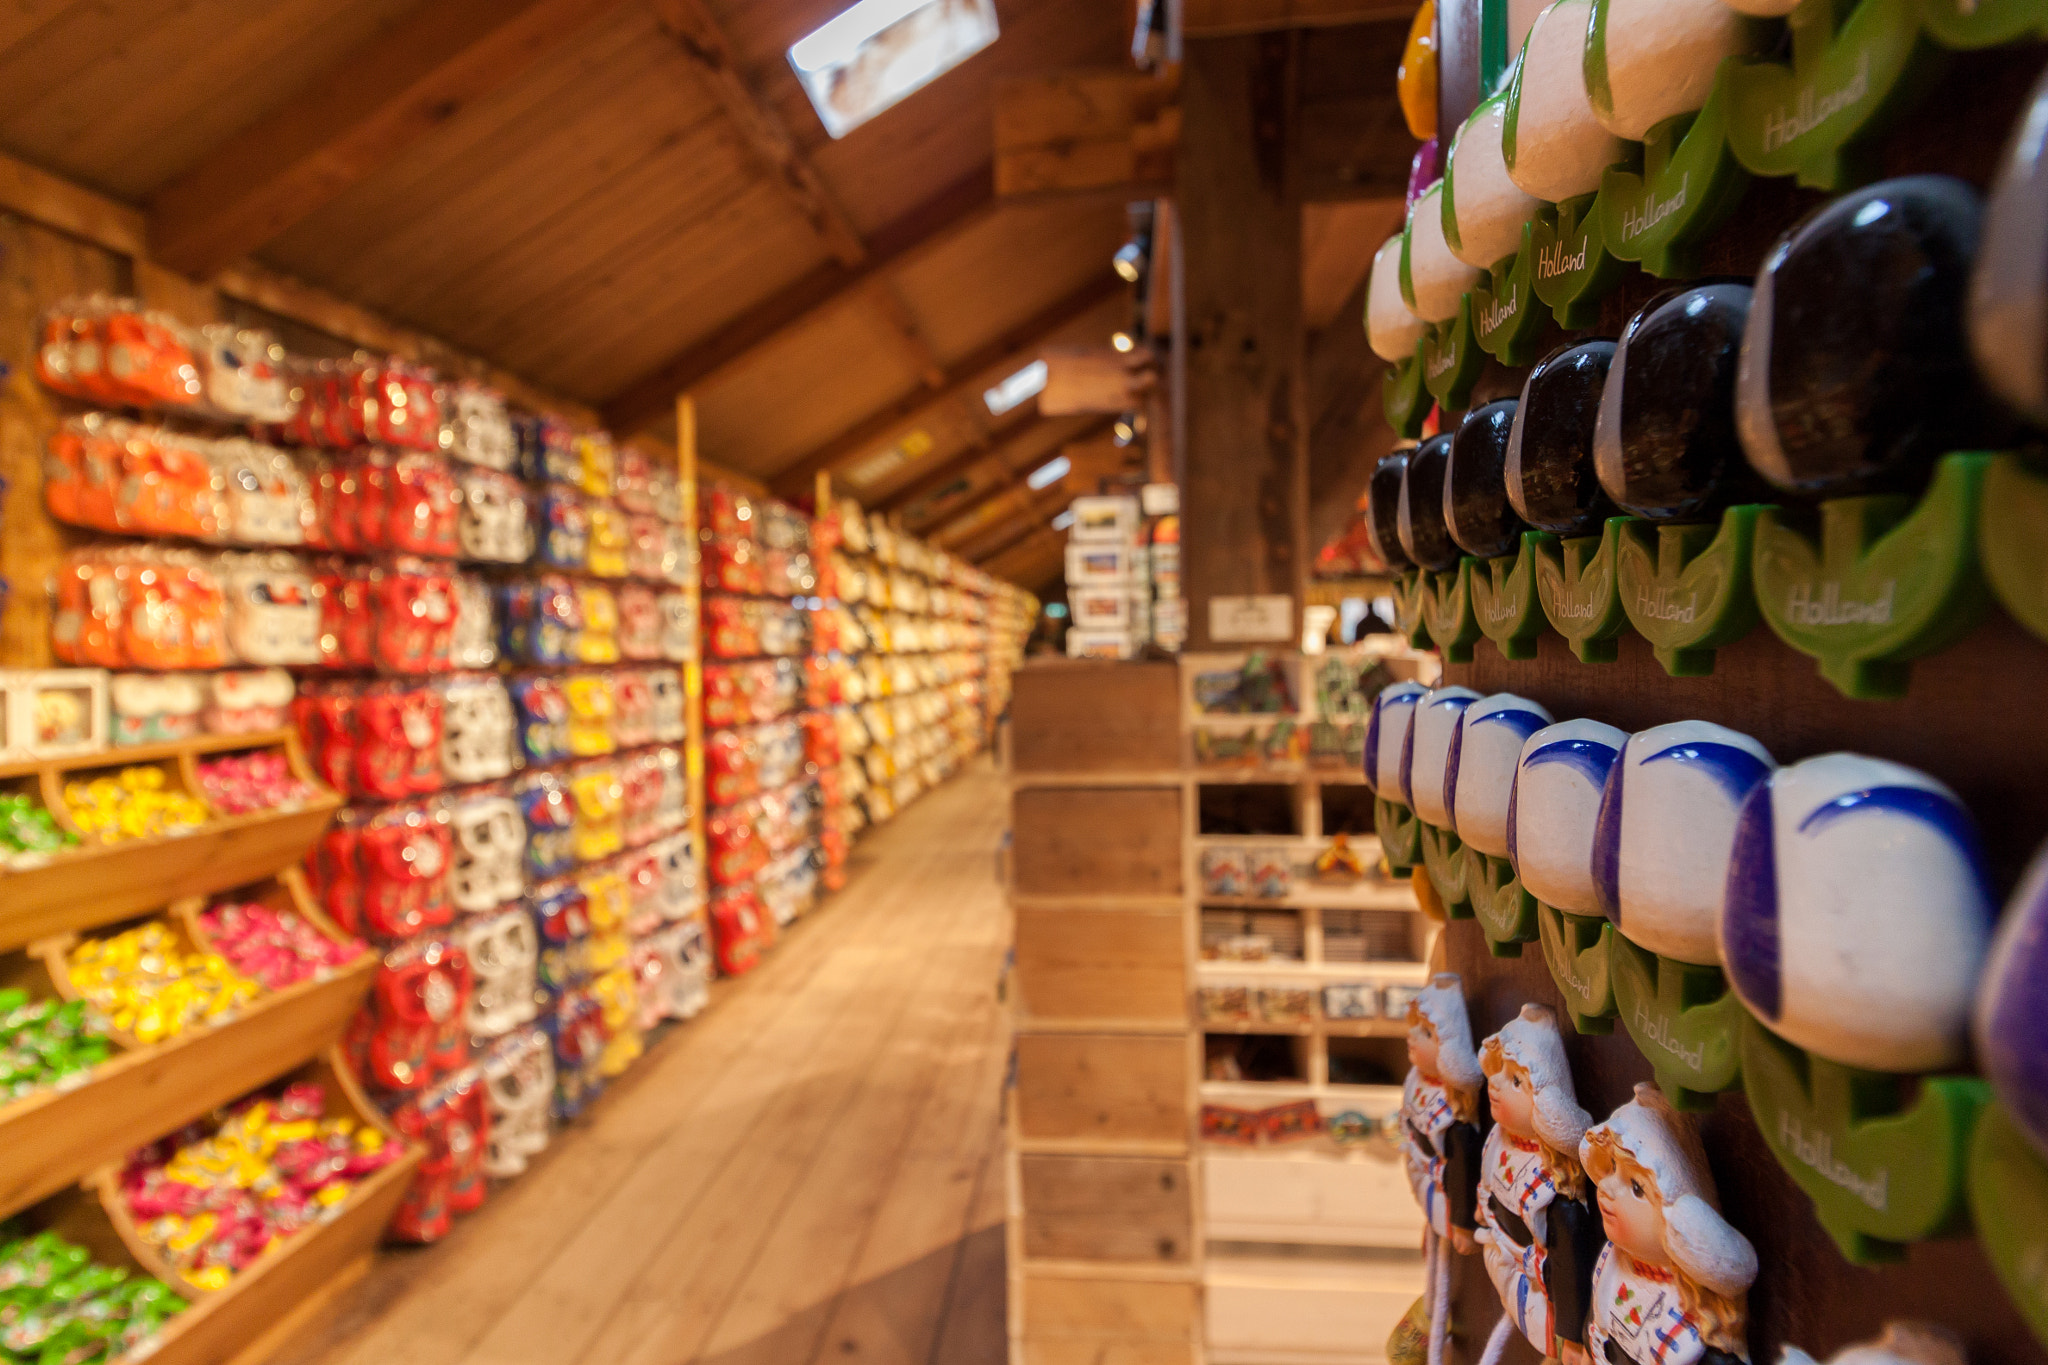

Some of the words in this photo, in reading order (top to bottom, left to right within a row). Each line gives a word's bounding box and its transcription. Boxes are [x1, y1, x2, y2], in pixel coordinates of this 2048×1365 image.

[1763, 50, 1869, 154] Holland
[1621, 171, 1691, 243] Holland
[1538, 234, 1587, 280] Holland
[1480, 284, 1517, 338] Holland
[1484, 594, 1517, 624] Holland
[1553, 591, 1594, 619] Holland
[1636, 584, 1697, 624] Holland
[1785, 578, 1897, 625] Holland
[1552, 955, 1592, 1001] Holland
[1634, 1000, 1704, 1074] Holland
[1779, 1110, 1890, 1213] Holland
